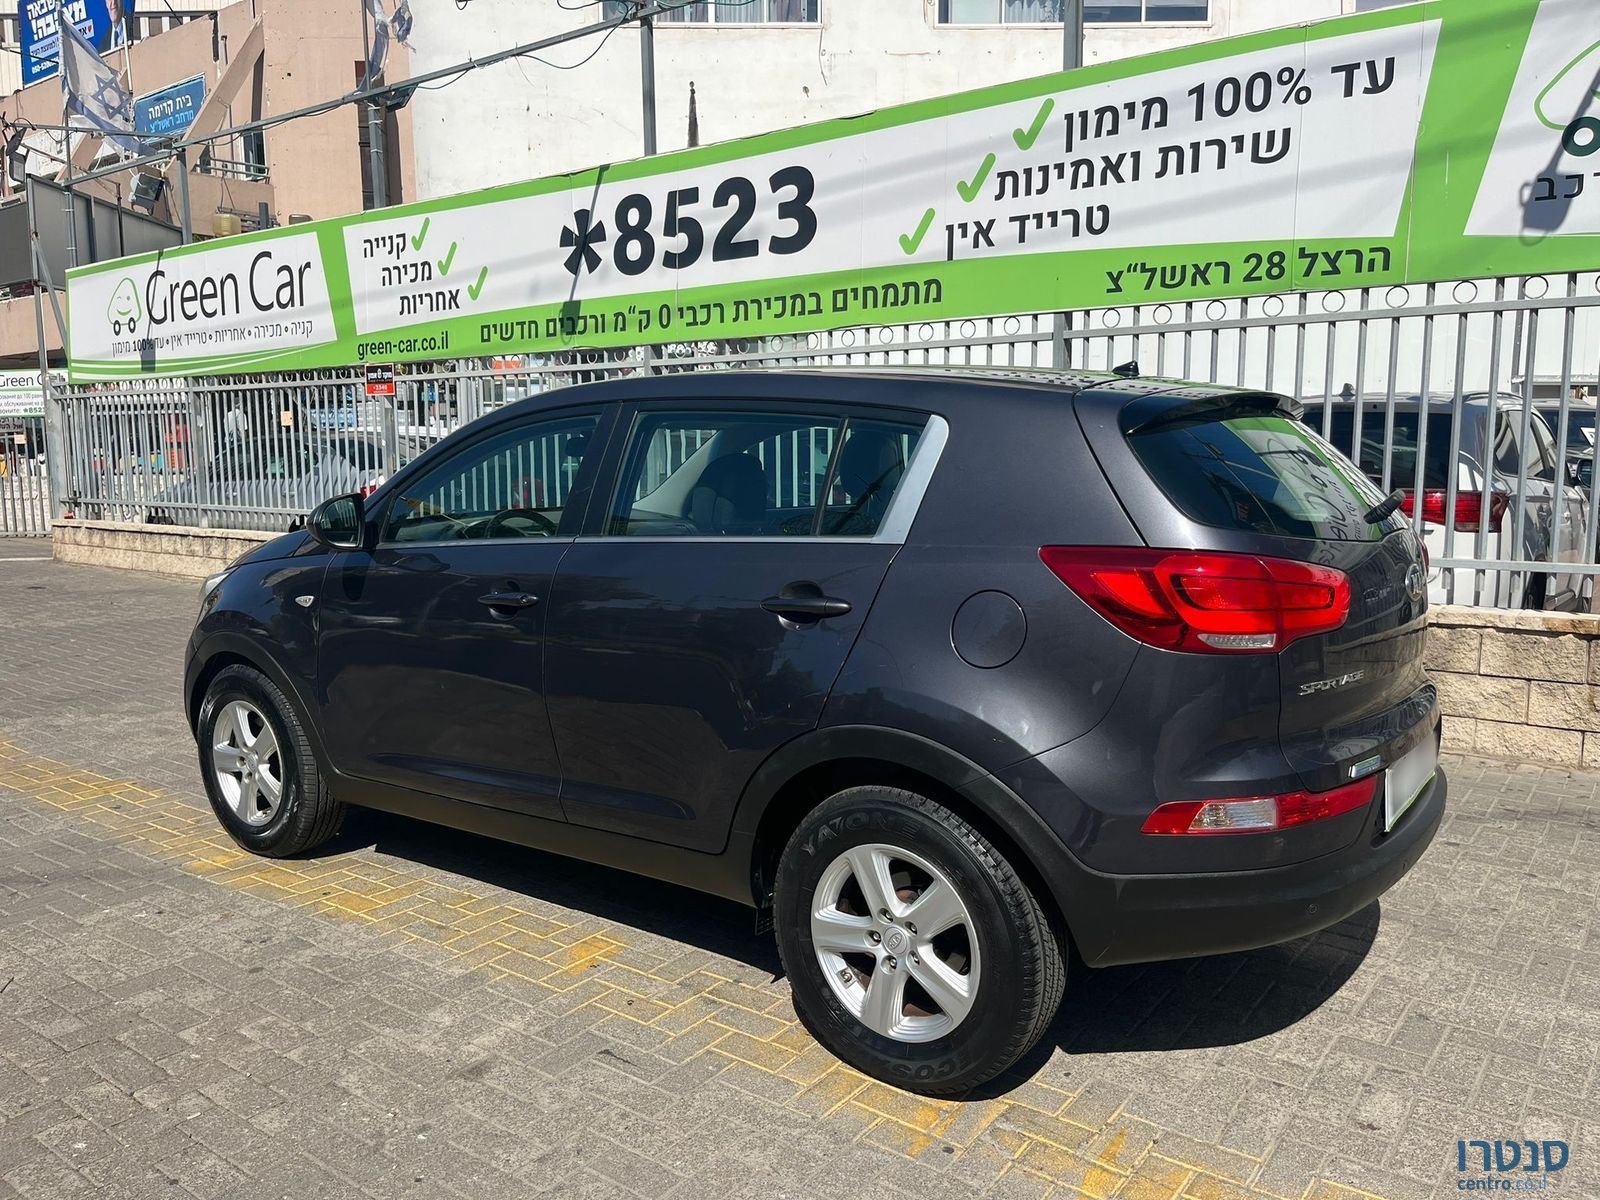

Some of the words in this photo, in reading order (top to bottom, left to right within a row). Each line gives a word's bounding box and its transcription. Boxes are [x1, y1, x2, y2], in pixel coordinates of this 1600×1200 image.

[1331, 56, 1396, 99] עד
[176, 95, 192, 110] בית
[1187, 66, 1312, 121] 100%
[148, 100, 174, 120] קדימה
[1063, 95, 1169, 153] מימון
[1154, 127, 1292, 179] שירות
[994, 152, 1140, 202] ואמינות
[1534, 172, 1600, 201] כב
[1008, 204, 1111, 243] טרייד
[363, 232, 407, 259] קנייה
[945, 218, 996, 261] אין
[382, 260, 433, 287] מכירה
[1243, 252, 1286, 282] 28
[1298, 246, 1391, 278] הרצל
[146, 269, 240, 326] Green
[249, 251, 312, 312] Car
[832, 277, 942, 312] מתמחים
[399, 289, 461, 316] אחריות
[658, 303, 671, 329] 0
[678, 300, 726, 327] רכבי
[733, 287, 823, 322] במכירת
[184, 332, 207, 345] טרייד
[214, 327, 246, 343] אחריות
[254, 323, 282, 339] מכירה
[291, 320, 313, 338] קניה
[480, 319, 539, 343] חדשים
[546, 314, 606, 338] ורכבים
[111, 340, 131, 358] מימון
[132, 338, 153, 351] 100%
[154, 338, 164, 350] עד
[170, 335, 182, 351] אין
[358, 330, 449, 360] green-car.co.il
[1299, 670, 1364, 695] SPORTAGE
